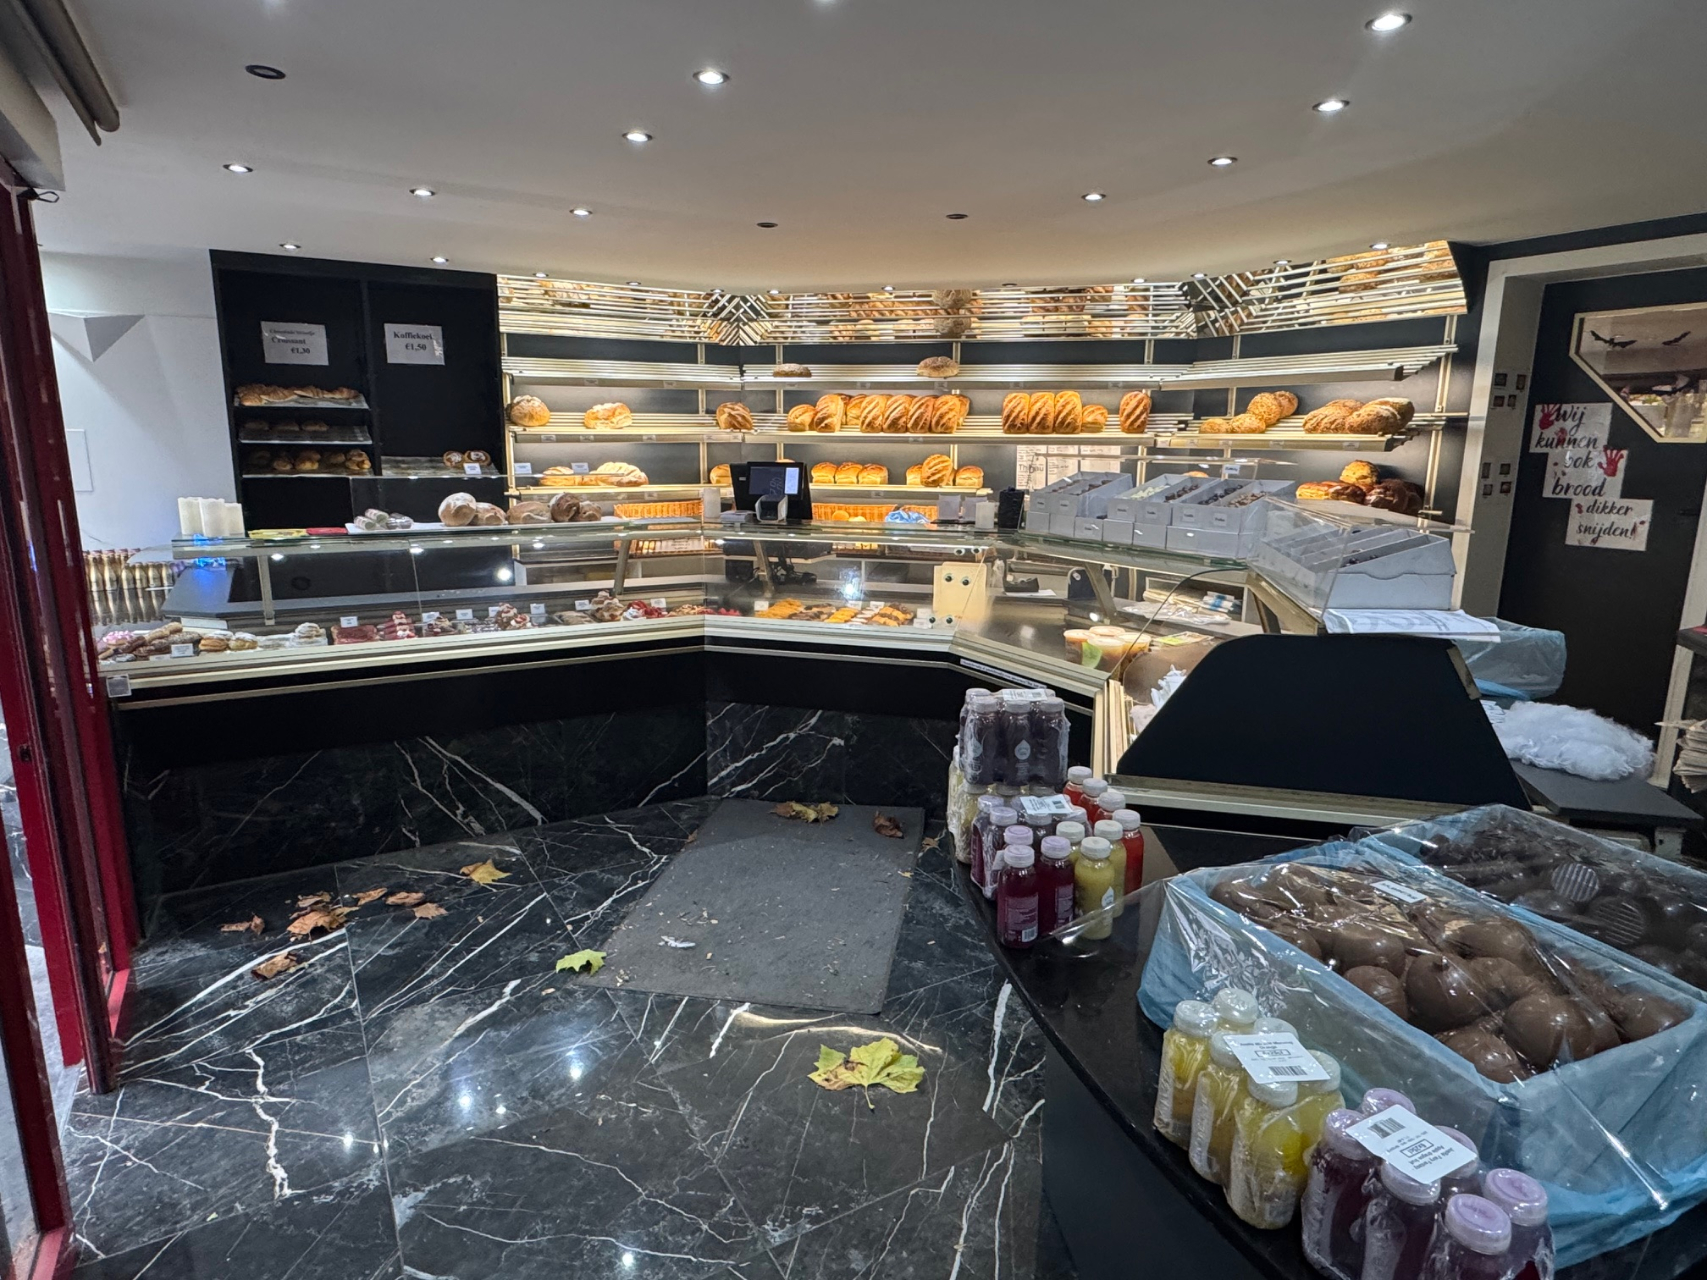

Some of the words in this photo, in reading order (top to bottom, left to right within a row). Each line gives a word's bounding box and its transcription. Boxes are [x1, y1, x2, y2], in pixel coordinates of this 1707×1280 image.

[405, 343, 427, 351] €1,50
[1554, 405, 1587, 436] Wij
[1534, 431, 1598, 449] kunnen
[1551, 477, 1607, 497] brood
[1586, 499, 1633, 516] dikker
[1576, 520, 1637, 543] snijden!
